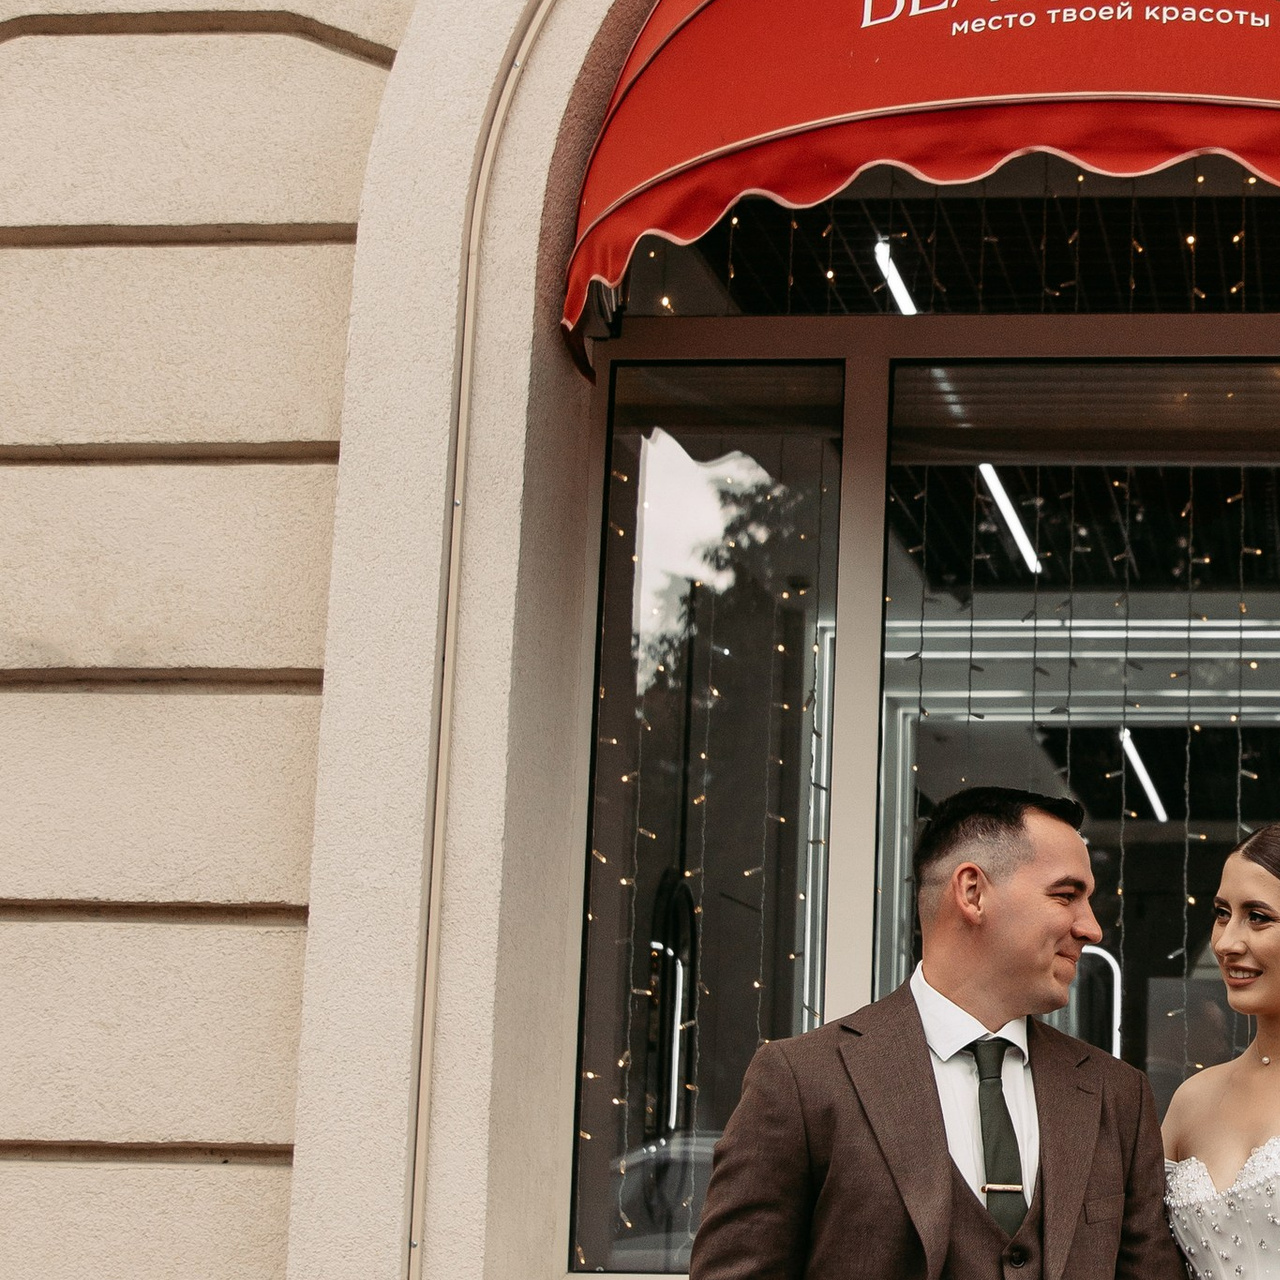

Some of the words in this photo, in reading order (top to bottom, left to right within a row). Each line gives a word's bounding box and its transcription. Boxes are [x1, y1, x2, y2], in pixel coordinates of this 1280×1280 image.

[951, 11, 1037, 36] место
[1046, 0, 1133, 24] твоей
[1144, 5, 1270, 28] красоты
